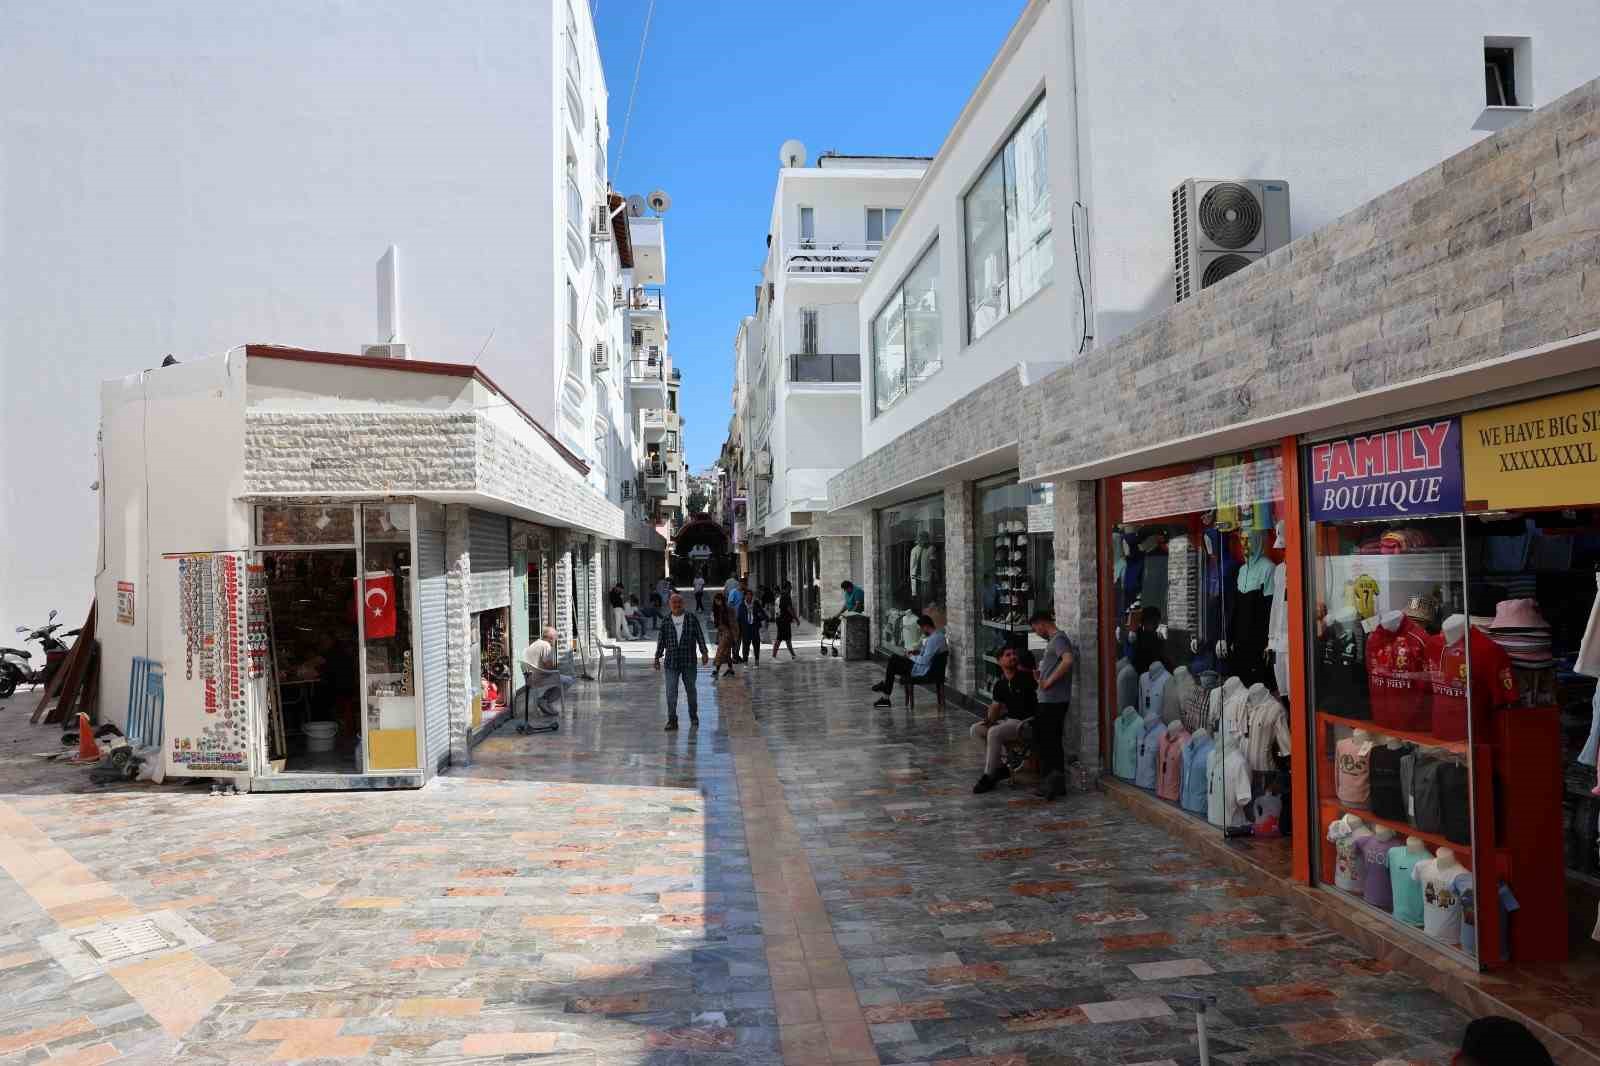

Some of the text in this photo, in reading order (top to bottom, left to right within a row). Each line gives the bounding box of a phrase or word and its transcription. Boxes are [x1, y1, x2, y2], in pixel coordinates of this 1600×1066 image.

[1478, 409, 1600, 447] WE HAVE BIG SI
[1312, 420, 1451, 484] FAMILY
[1321, 477, 1443, 512] BOUTIQUE
